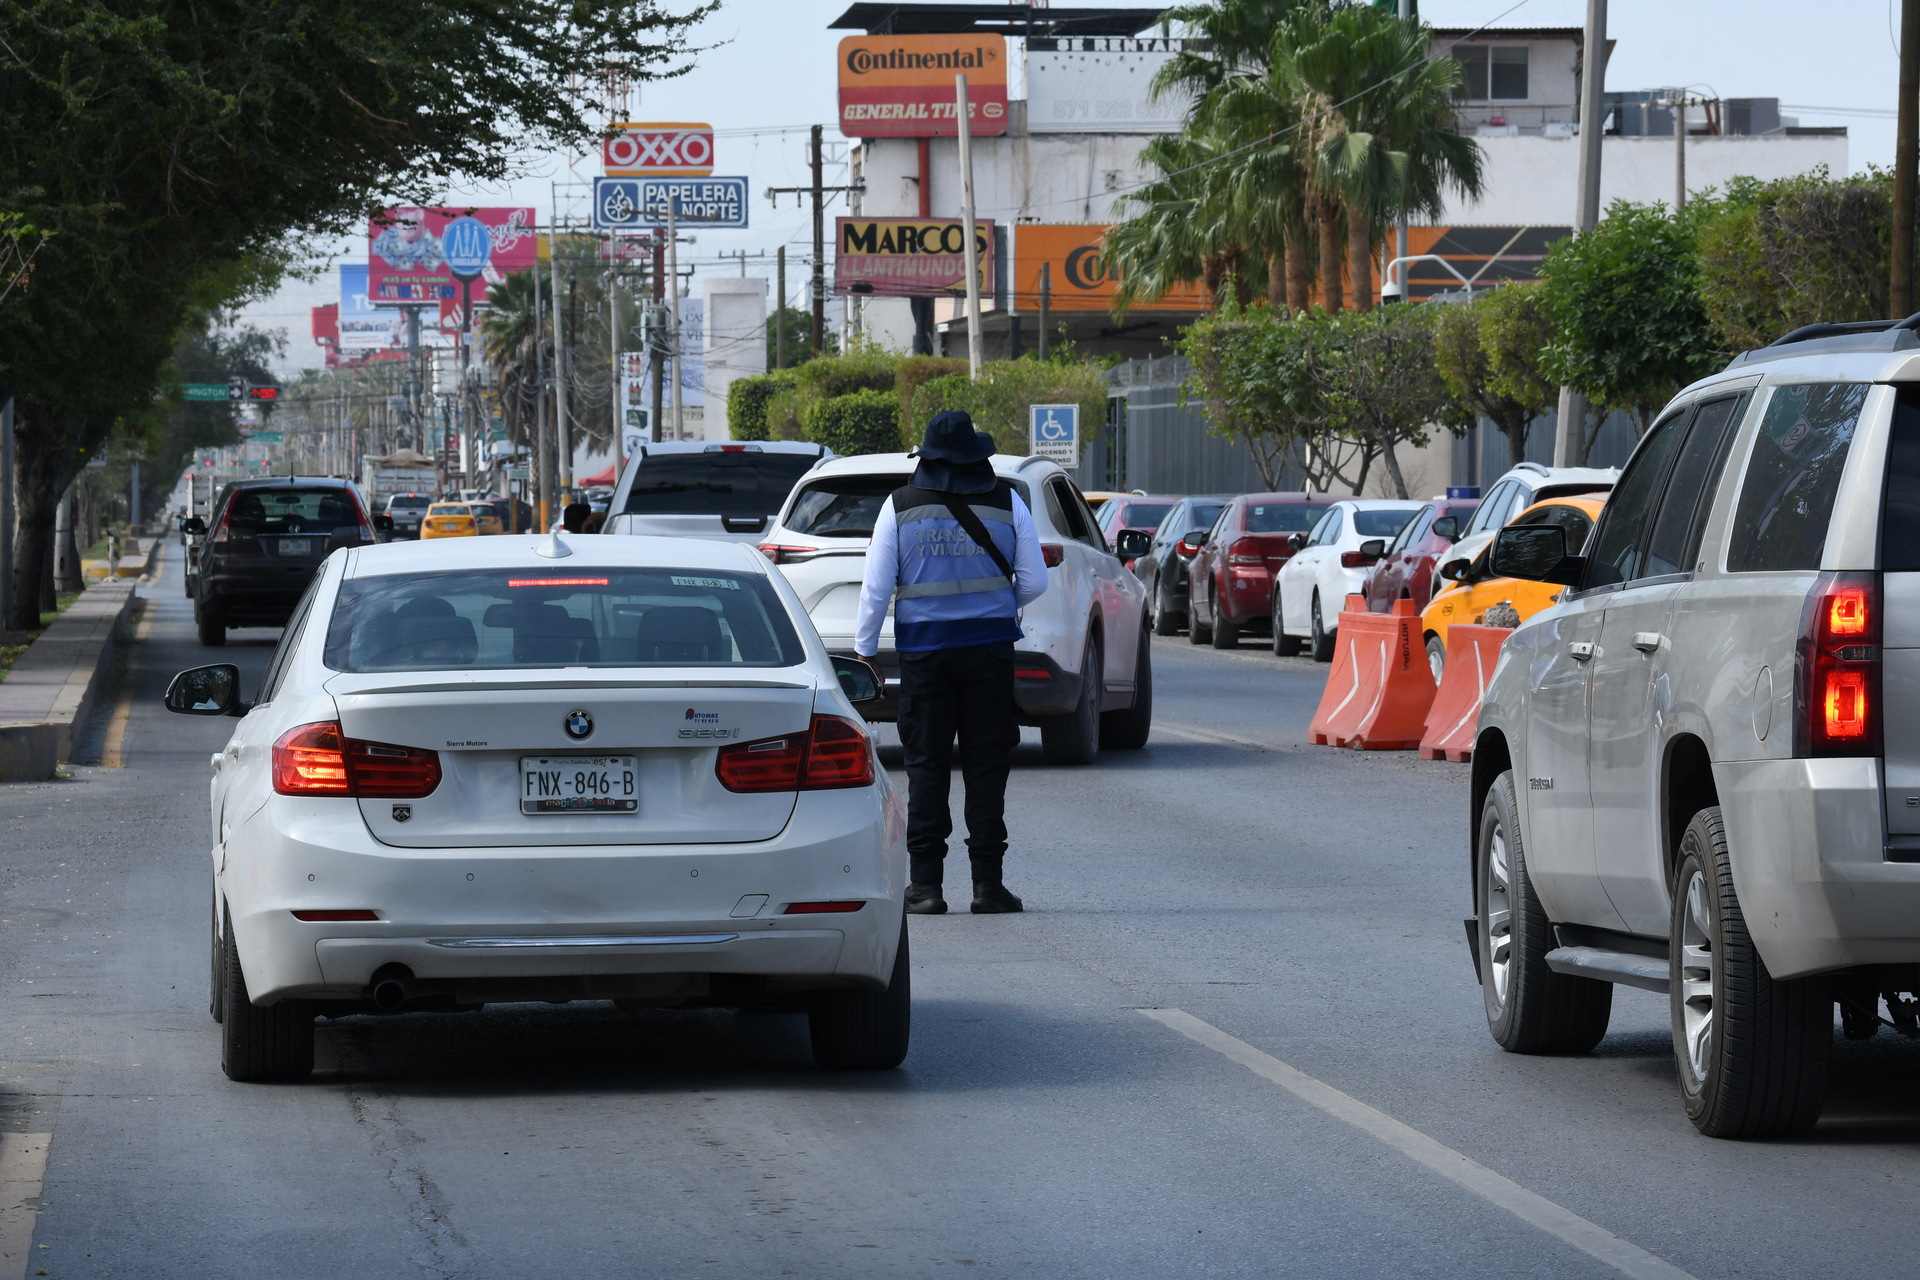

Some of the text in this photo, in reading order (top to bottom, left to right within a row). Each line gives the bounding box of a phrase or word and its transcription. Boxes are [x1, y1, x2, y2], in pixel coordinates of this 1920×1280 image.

[1056, 38, 1183, 51] SE RENTAN
[847, 48, 983, 74] Continental
[844, 103, 929, 120] GENERAL
[1052, 100, 1089, 119] 871
[1094, 100, 1132, 119] 222
[608, 134, 710, 165] OXXO
[645, 185, 738, 202] PAPELERA
[682, 202, 738, 220] NORTE
[843, 223, 988, 254] MARCOS
[686, 313, 704, 322] CAS
[187, 387, 226, 398] INGTON
[916, 543, 986, 557] Y VIALIDA
[526, 771, 634, 796] FNX-846-B
